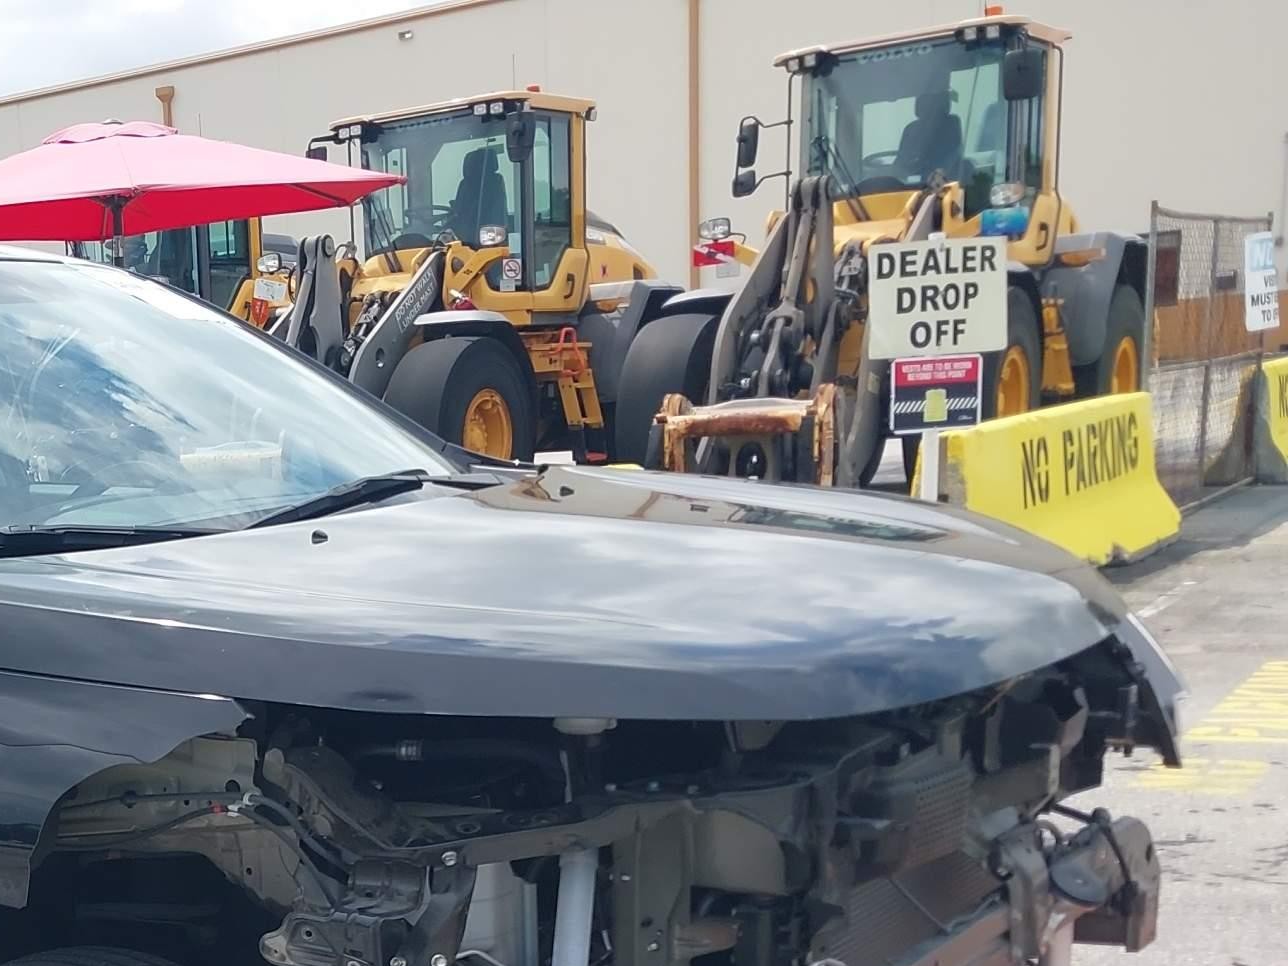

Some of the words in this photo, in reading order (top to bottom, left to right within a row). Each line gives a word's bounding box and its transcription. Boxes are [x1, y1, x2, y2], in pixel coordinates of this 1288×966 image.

[876, 245, 997, 280] DEALER
[417, 266, 434, 292] WALK
[896, 281, 979, 315] DROP
[402, 302, 421, 329] UNDER
[910, 318, 967, 349] OFF
[1021, 436, 1049, 510] NO
[1062, 411, 1139, 496] PARKING
